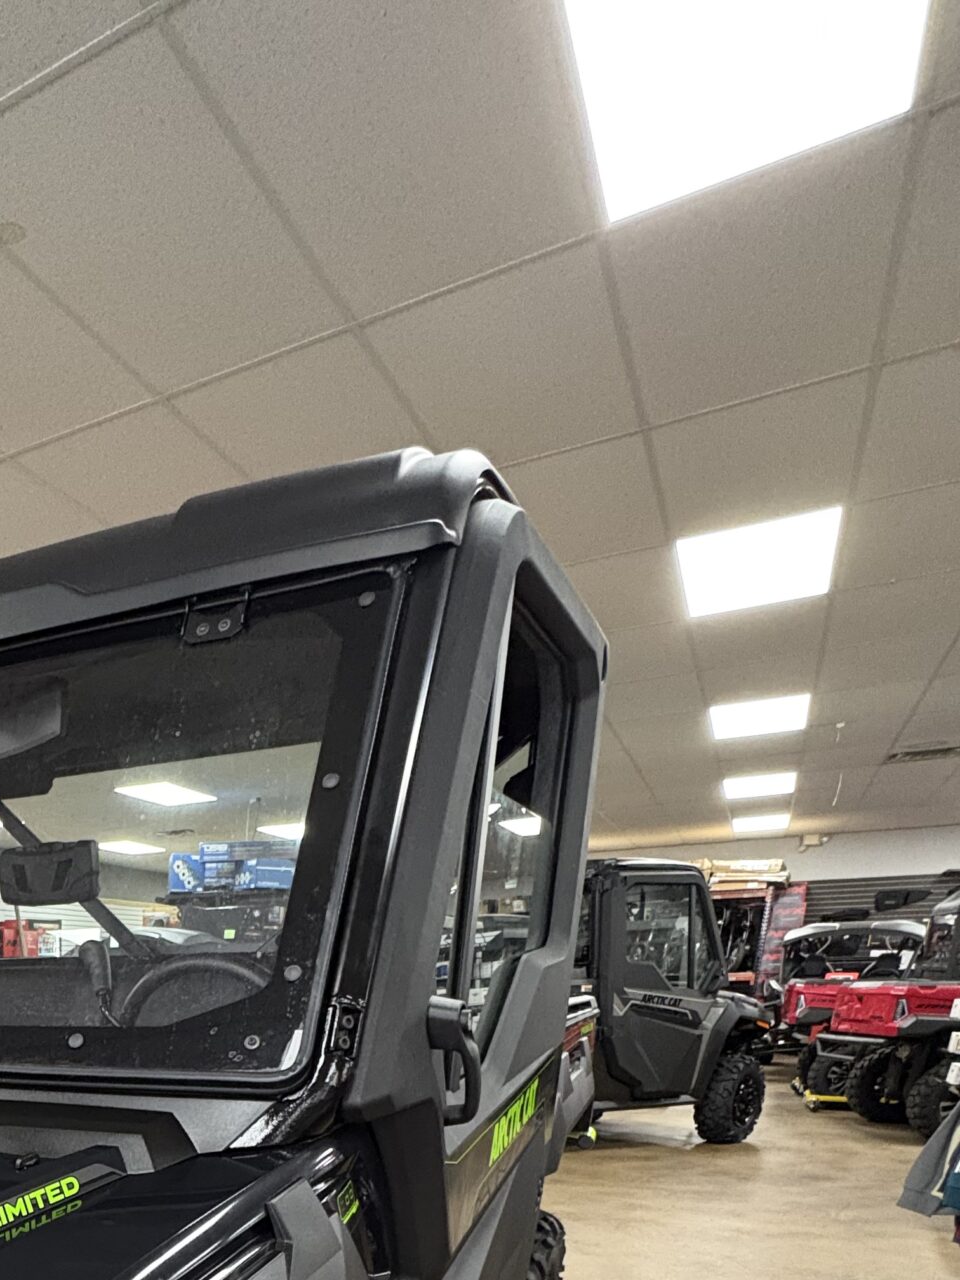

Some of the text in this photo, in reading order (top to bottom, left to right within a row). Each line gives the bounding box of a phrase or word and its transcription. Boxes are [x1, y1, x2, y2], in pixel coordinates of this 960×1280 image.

[641, 993, 683, 1008] ARCTIC CAT
[488, 1077, 539, 1168] ARCTIC CAT
